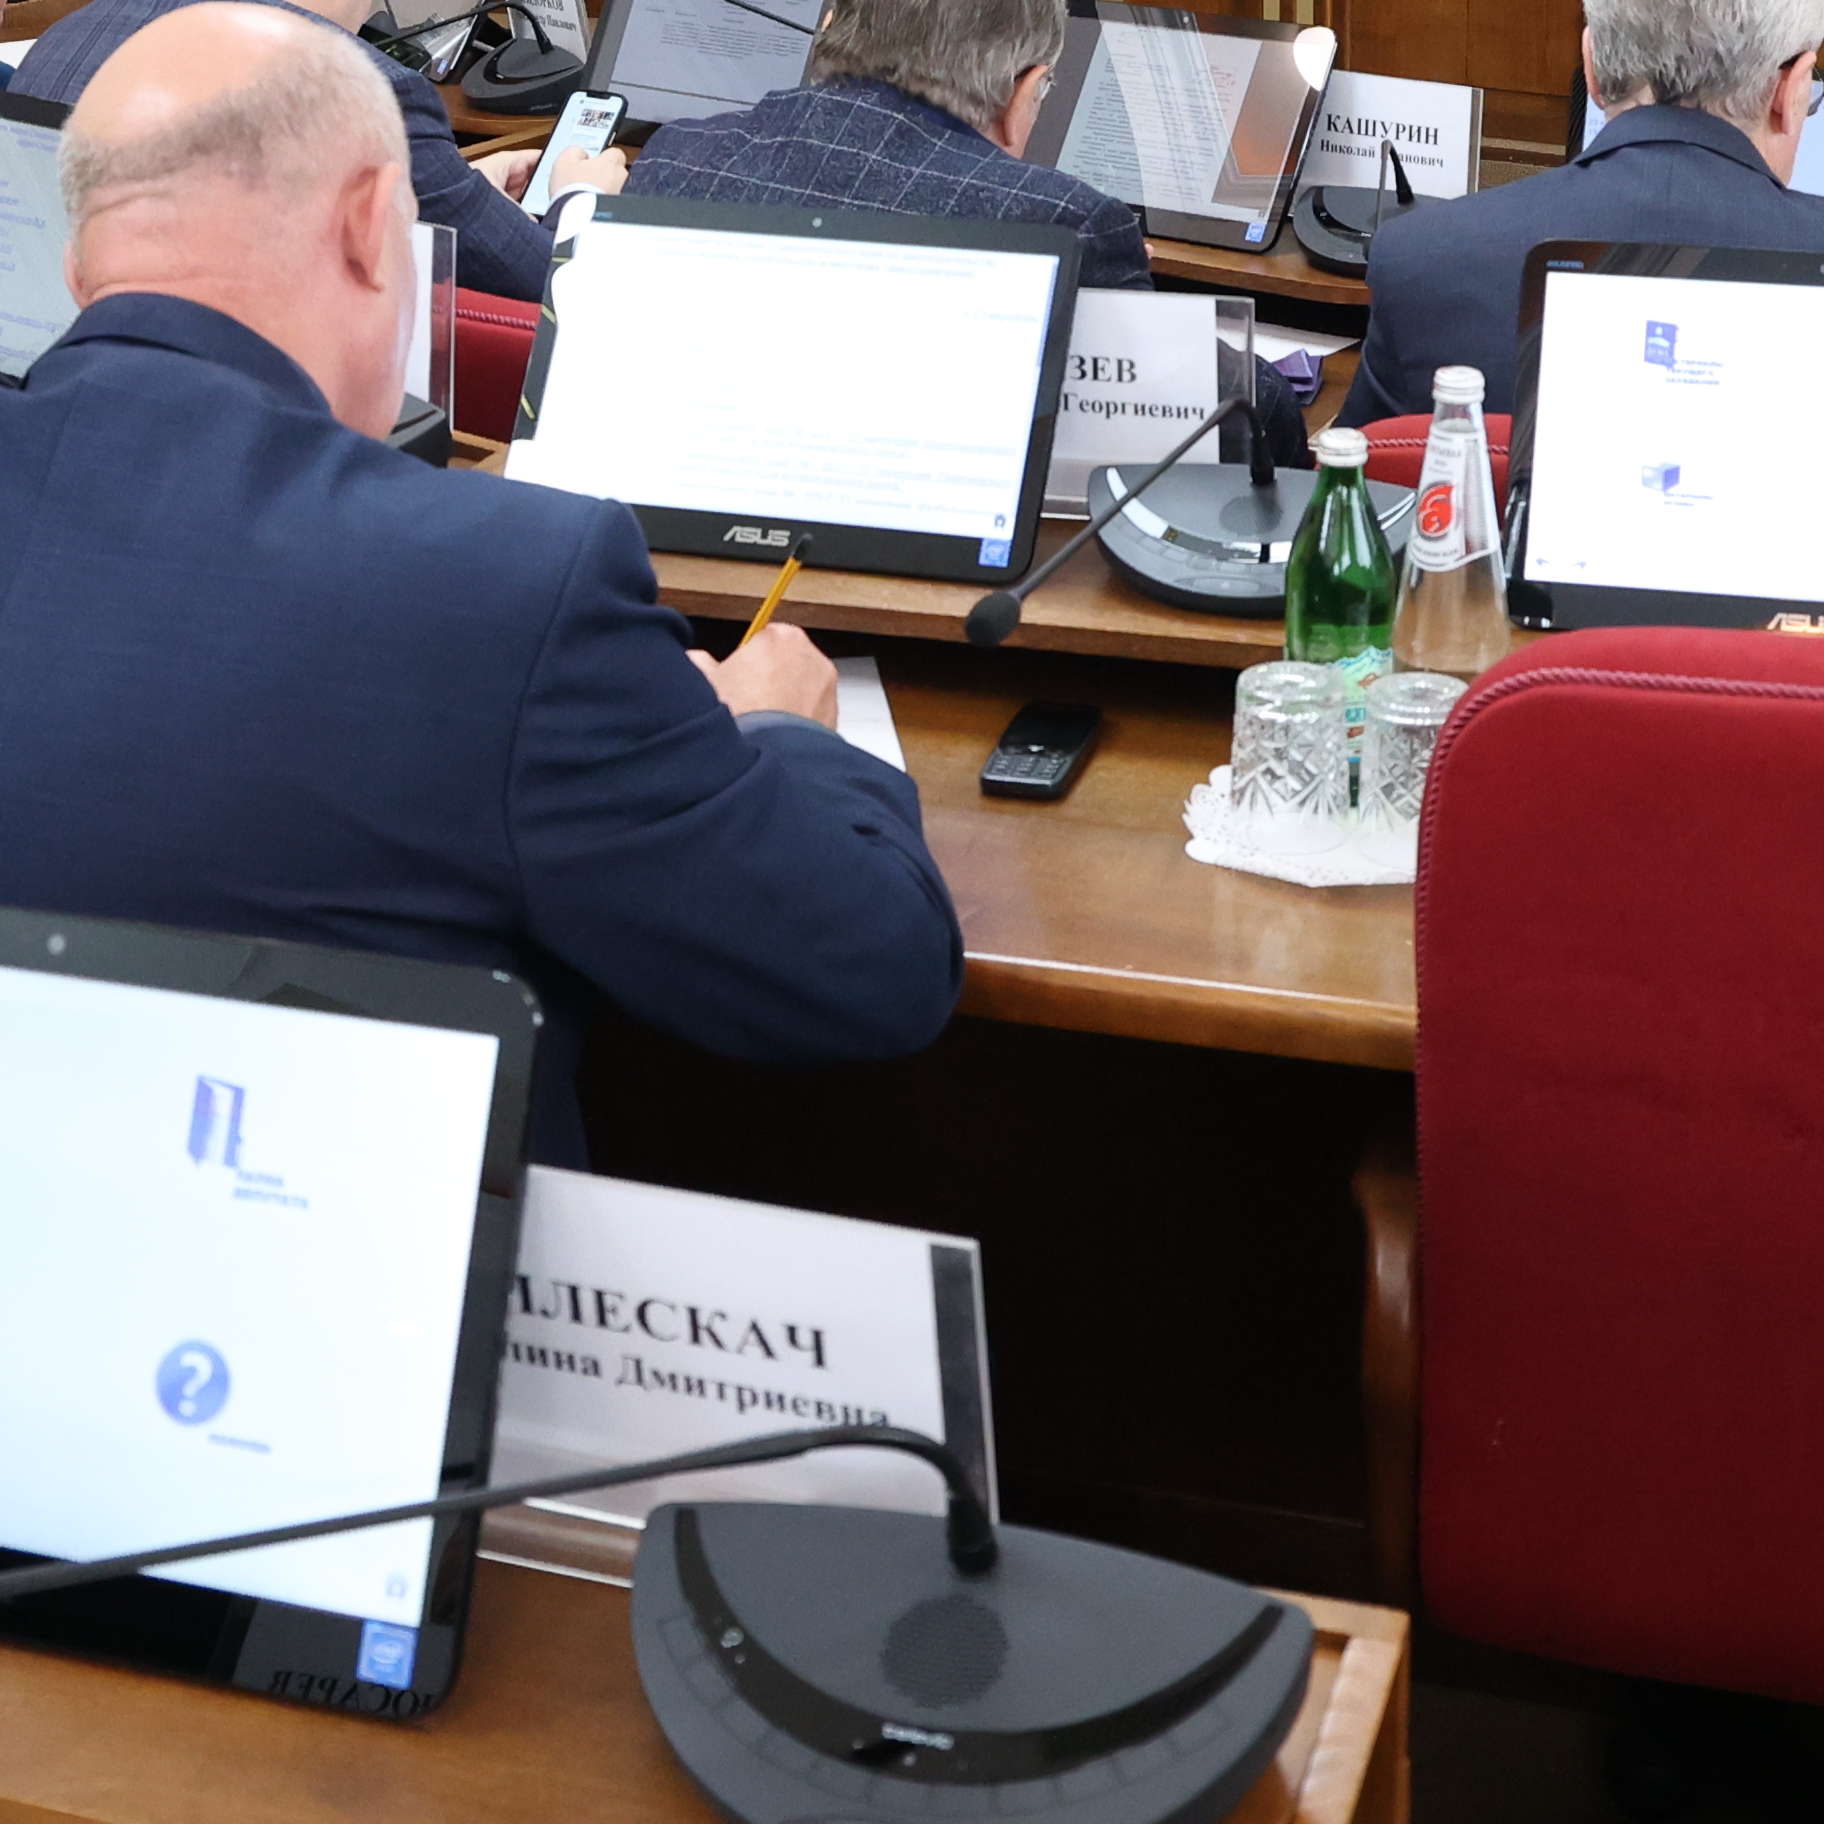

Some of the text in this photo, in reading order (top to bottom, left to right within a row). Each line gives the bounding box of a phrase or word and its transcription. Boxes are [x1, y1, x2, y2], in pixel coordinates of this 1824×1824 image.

[1326, 113, 1439, 146] КАШУРИН
[1320, 139, 1375, 159] Николай
[1062, 392, 1205, 422] Георгиевич
[723, 525, 791, 548] ASUS
[615, 1355, 891, 1429] Дмитриевна
